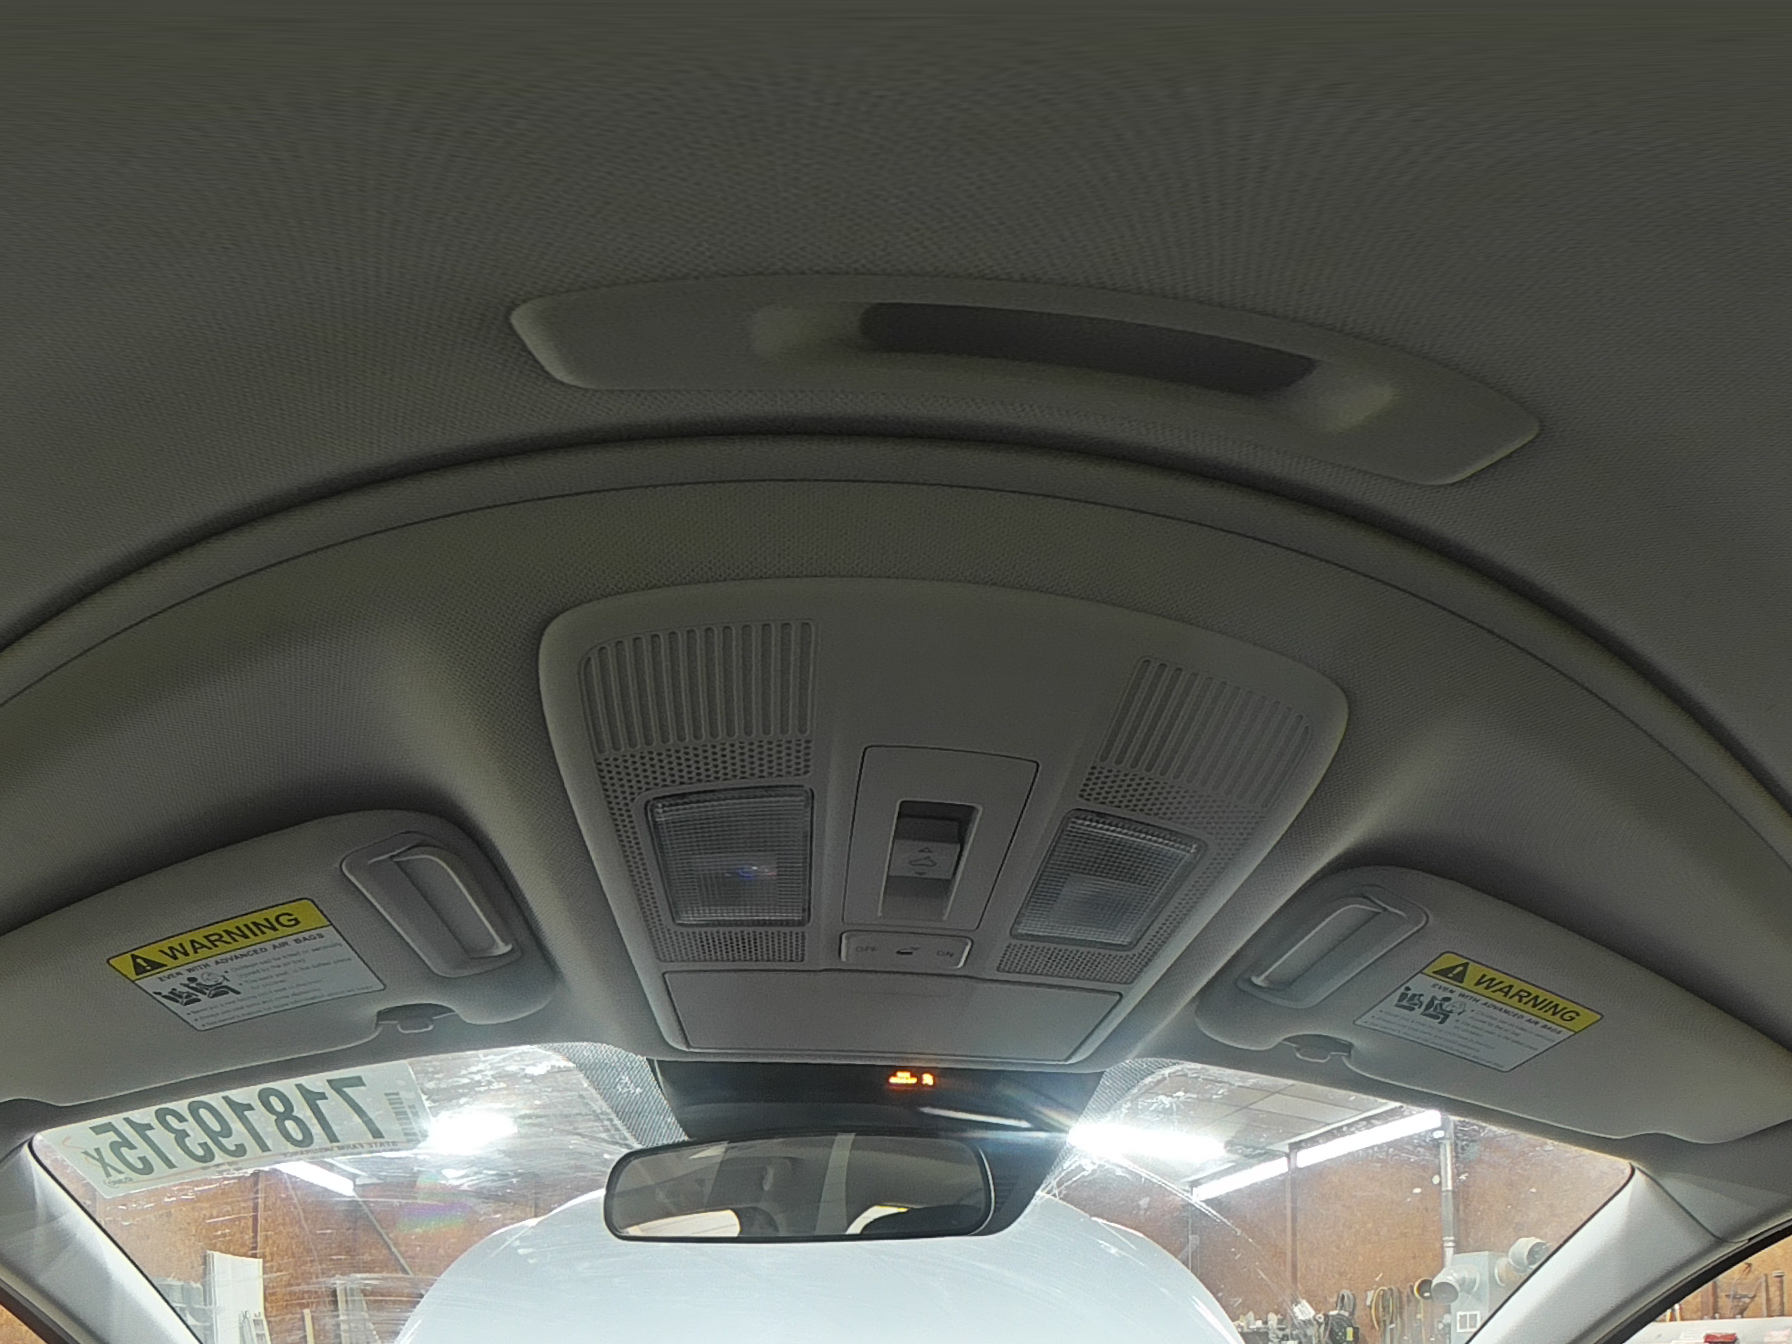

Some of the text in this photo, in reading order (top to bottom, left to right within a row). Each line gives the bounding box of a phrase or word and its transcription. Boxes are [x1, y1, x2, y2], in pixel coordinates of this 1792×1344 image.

[159, 911, 301, 961] WARNING
[186, 963, 212, 975] WITH
[214, 946, 268, 967] ADVANCED
[271, 940, 291, 952] AIR
[293, 932, 325, 945] BAGS
[1474, 973, 1581, 1023] WARNING
[1483, 999, 1525, 1021] ADVANCED
